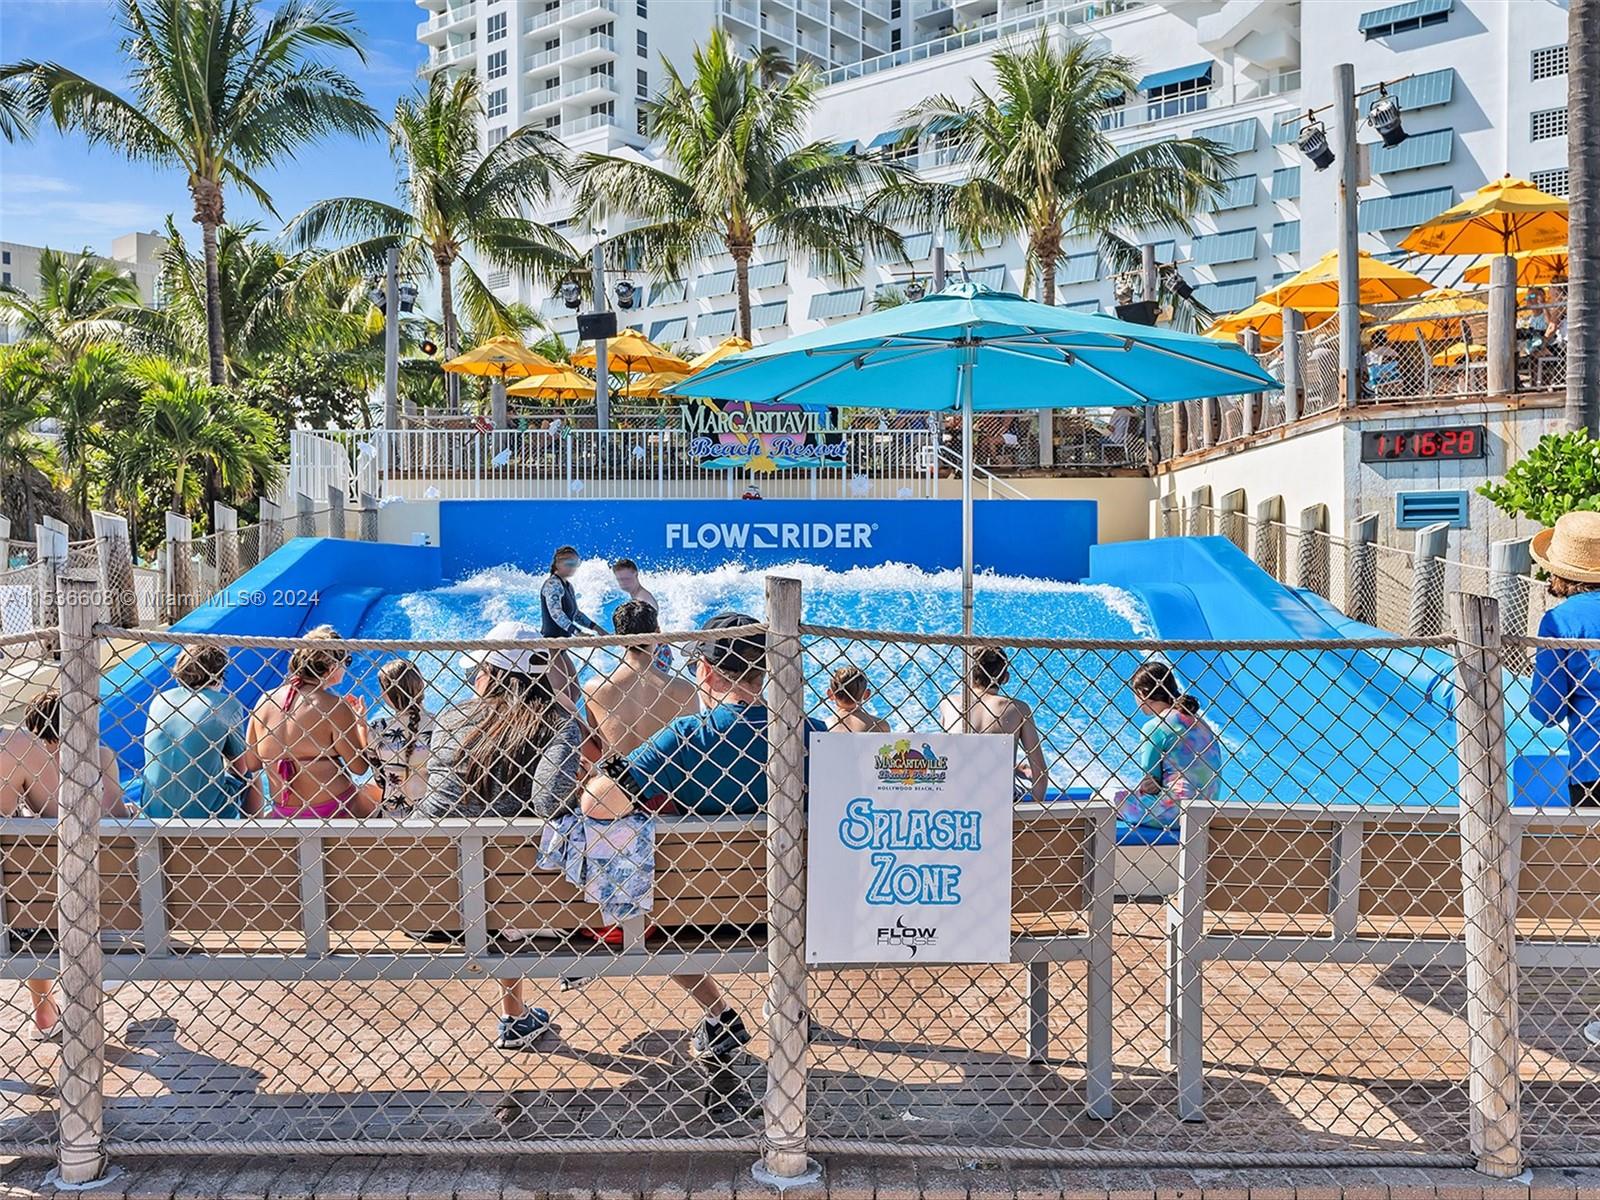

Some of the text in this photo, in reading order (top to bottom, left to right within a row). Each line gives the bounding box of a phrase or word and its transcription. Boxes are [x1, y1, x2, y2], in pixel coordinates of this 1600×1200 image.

[679, 404, 851, 434] MARGARITAVILLE
[688, 436, 849, 459] Beach Resort
[1378, 430, 1475, 457] 11:16:28
[665, 522, 750, 549] FLOW
[874, 755, 948, 770] MARGARITAVILLE
[839, 797, 982, 850] SPLASH
[866, 853, 962, 904] ZONE
[876, 938, 938, 946] HOUSE
[877, 928, 937, 938] FLOW
